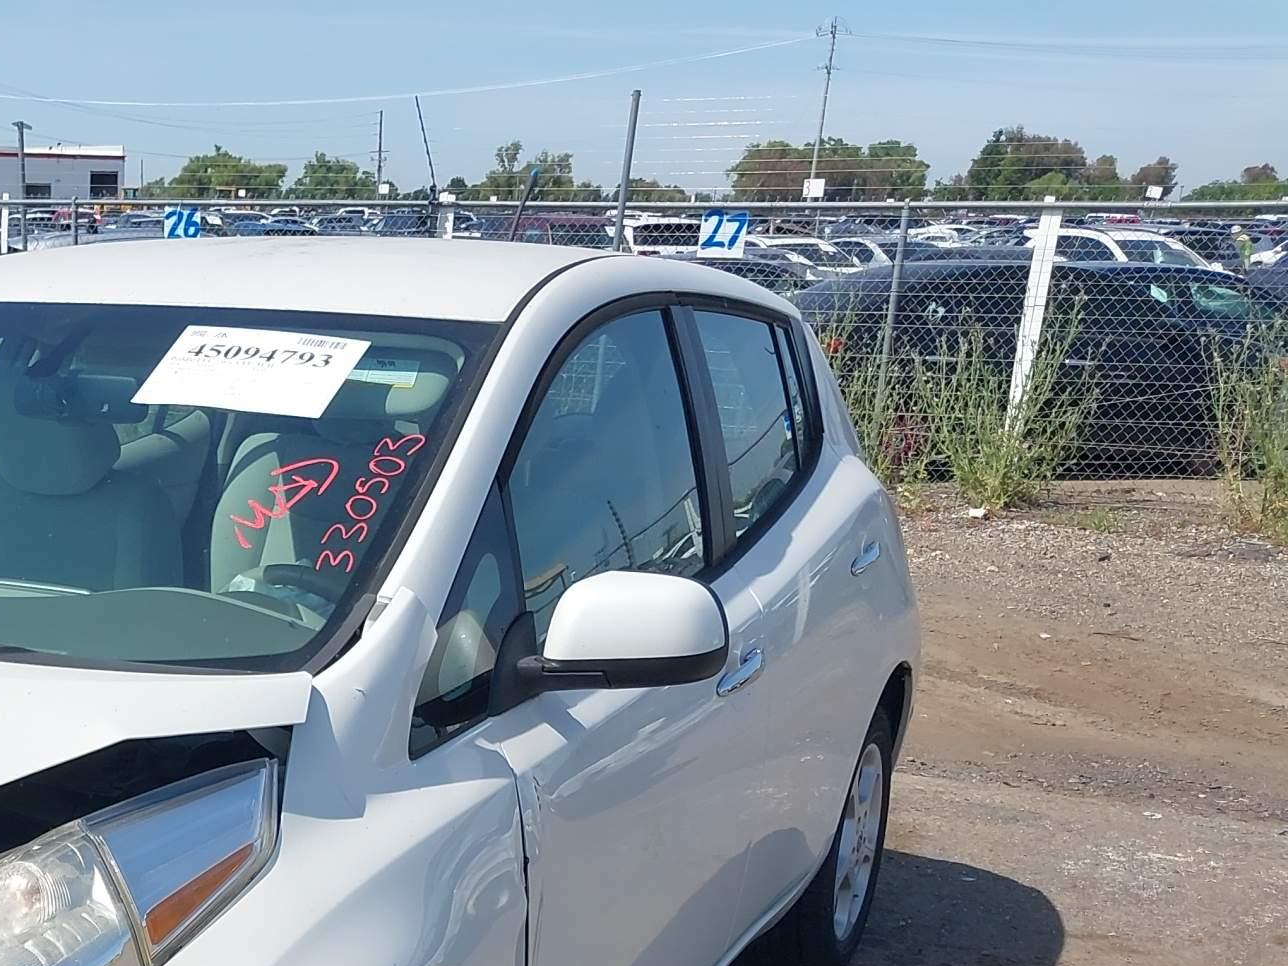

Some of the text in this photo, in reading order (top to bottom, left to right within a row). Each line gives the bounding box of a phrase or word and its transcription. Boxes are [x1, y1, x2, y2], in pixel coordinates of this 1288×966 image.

[165, 207, 201, 238] 26
[700, 208, 749, 250] 27
[187, 343, 334, 368] 45094793
